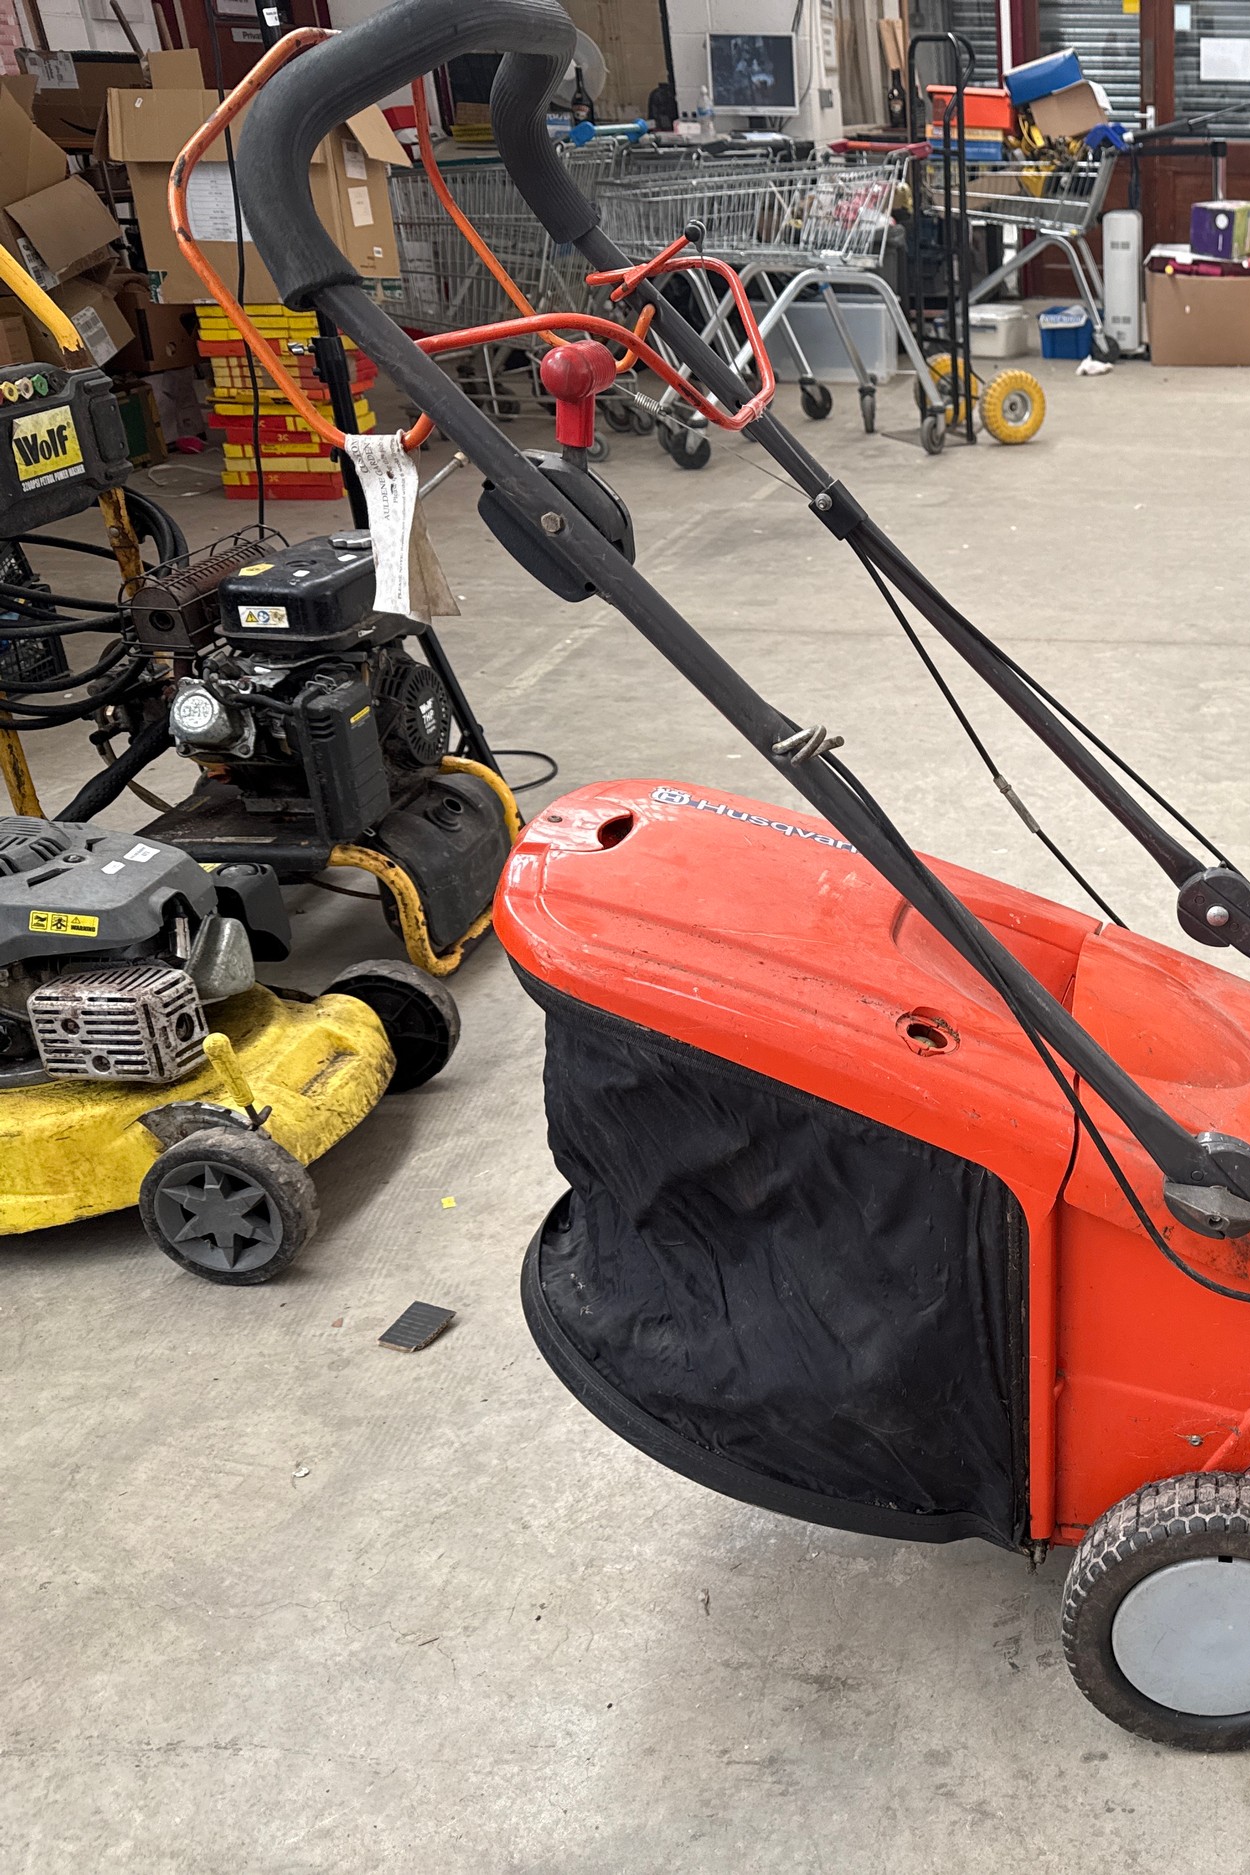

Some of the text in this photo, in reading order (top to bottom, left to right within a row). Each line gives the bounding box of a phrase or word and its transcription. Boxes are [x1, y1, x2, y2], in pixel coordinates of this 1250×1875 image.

[242, 31, 261, 39] Priva
[13, 424, 69, 467] Wolf
[378, 477, 391, 521] AULDENE
[697, 800, 860, 853] Husqvarn
